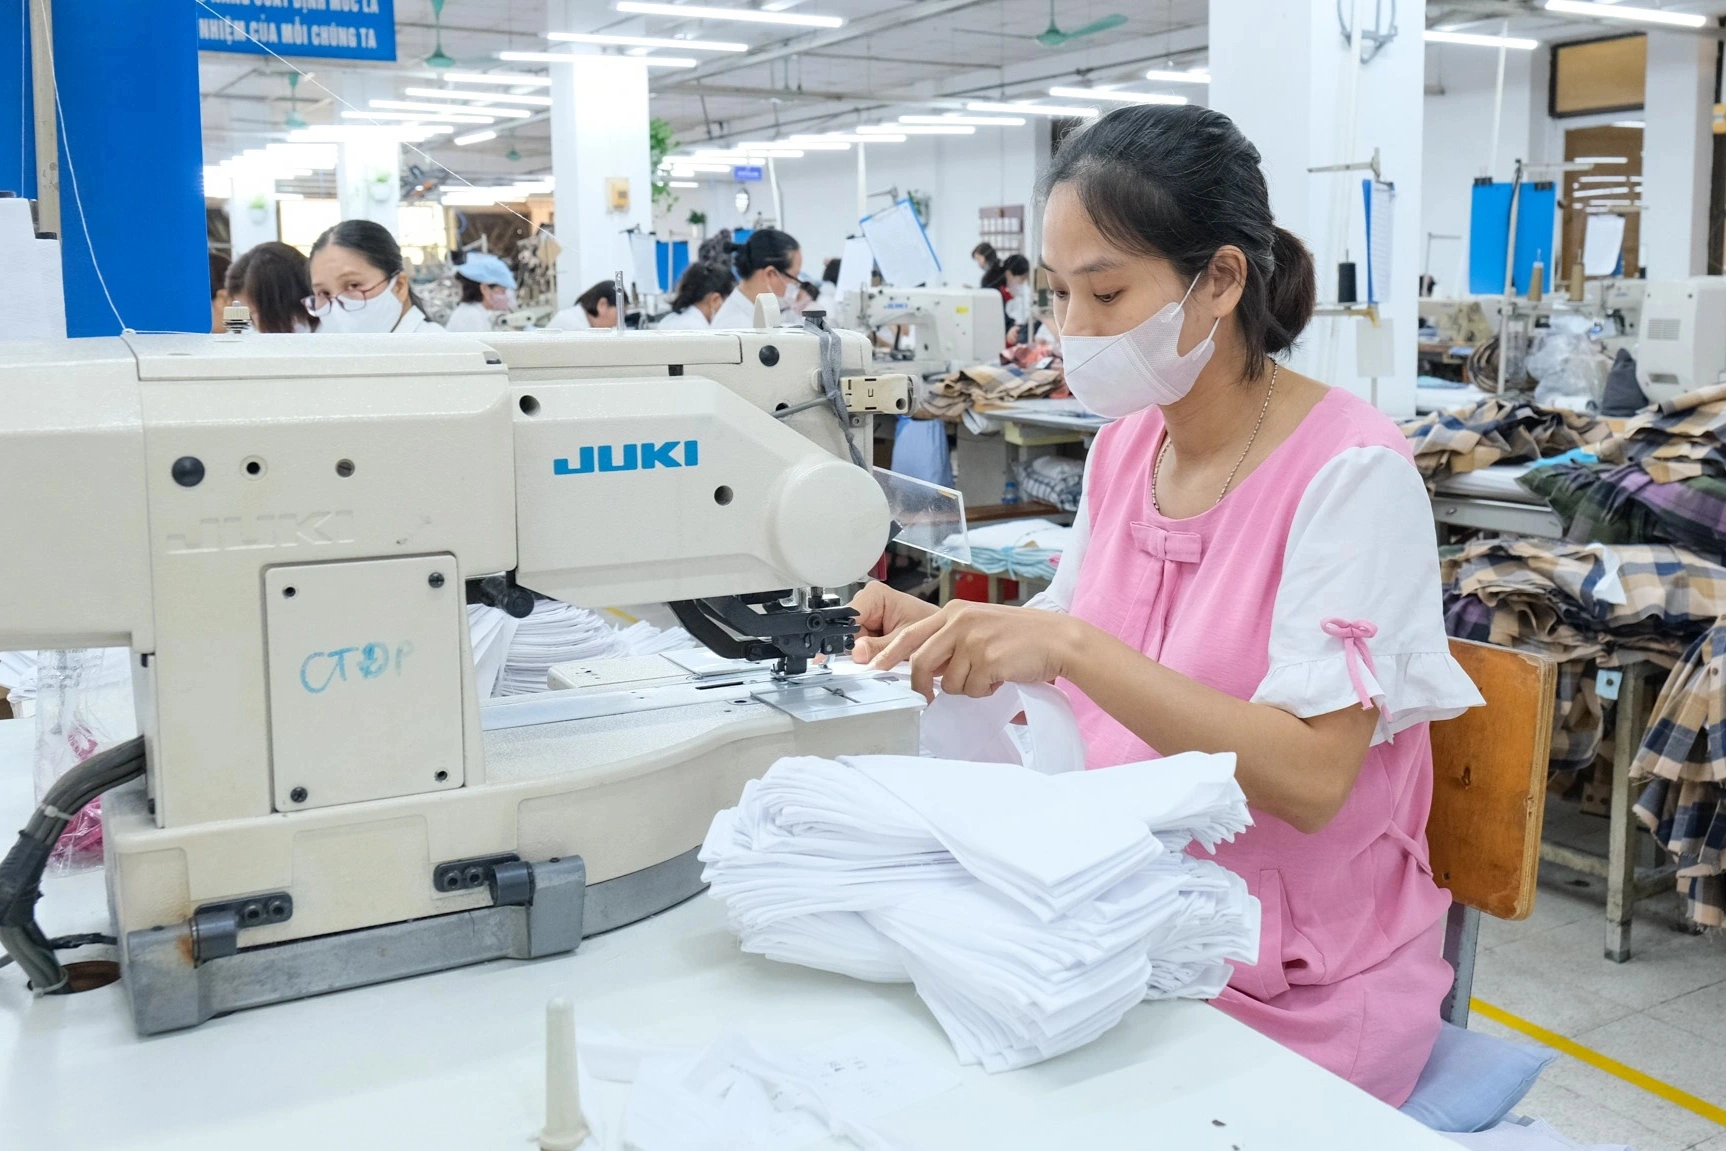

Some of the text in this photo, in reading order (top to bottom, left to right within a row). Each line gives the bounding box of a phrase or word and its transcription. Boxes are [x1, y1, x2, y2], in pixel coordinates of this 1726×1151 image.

[311, 22, 358, 48] CHÚNG
[359, 27, 378, 49] TA
[553, 440, 699, 475] JUKI
[166, 510, 355, 554] JUKI
